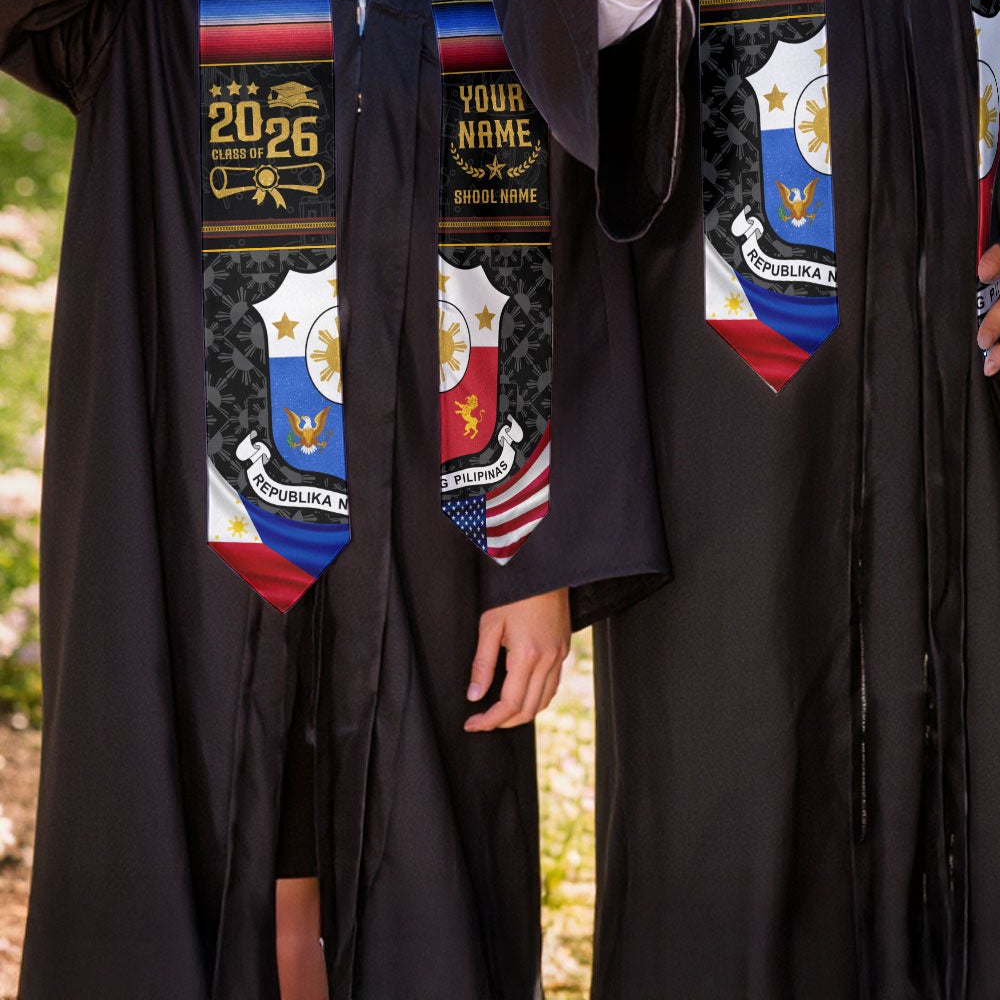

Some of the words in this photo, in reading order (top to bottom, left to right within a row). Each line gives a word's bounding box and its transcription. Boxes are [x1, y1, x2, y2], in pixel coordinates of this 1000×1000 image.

[459, 83, 526, 113] YOUR
[458, 118, 532, 149] NAME
[211, 148, 247, 160] CLASS
[250, 147, 264, 159] OF
[454, 189, 498, 205] SHOOL
[500, 188, 538, 204] NAME
[747, 248, 821, 280] REPUBLIKA
[454, 460, 508, 486] PILIPINAS
[252, 473, 332, 507] REPUBLIKA
